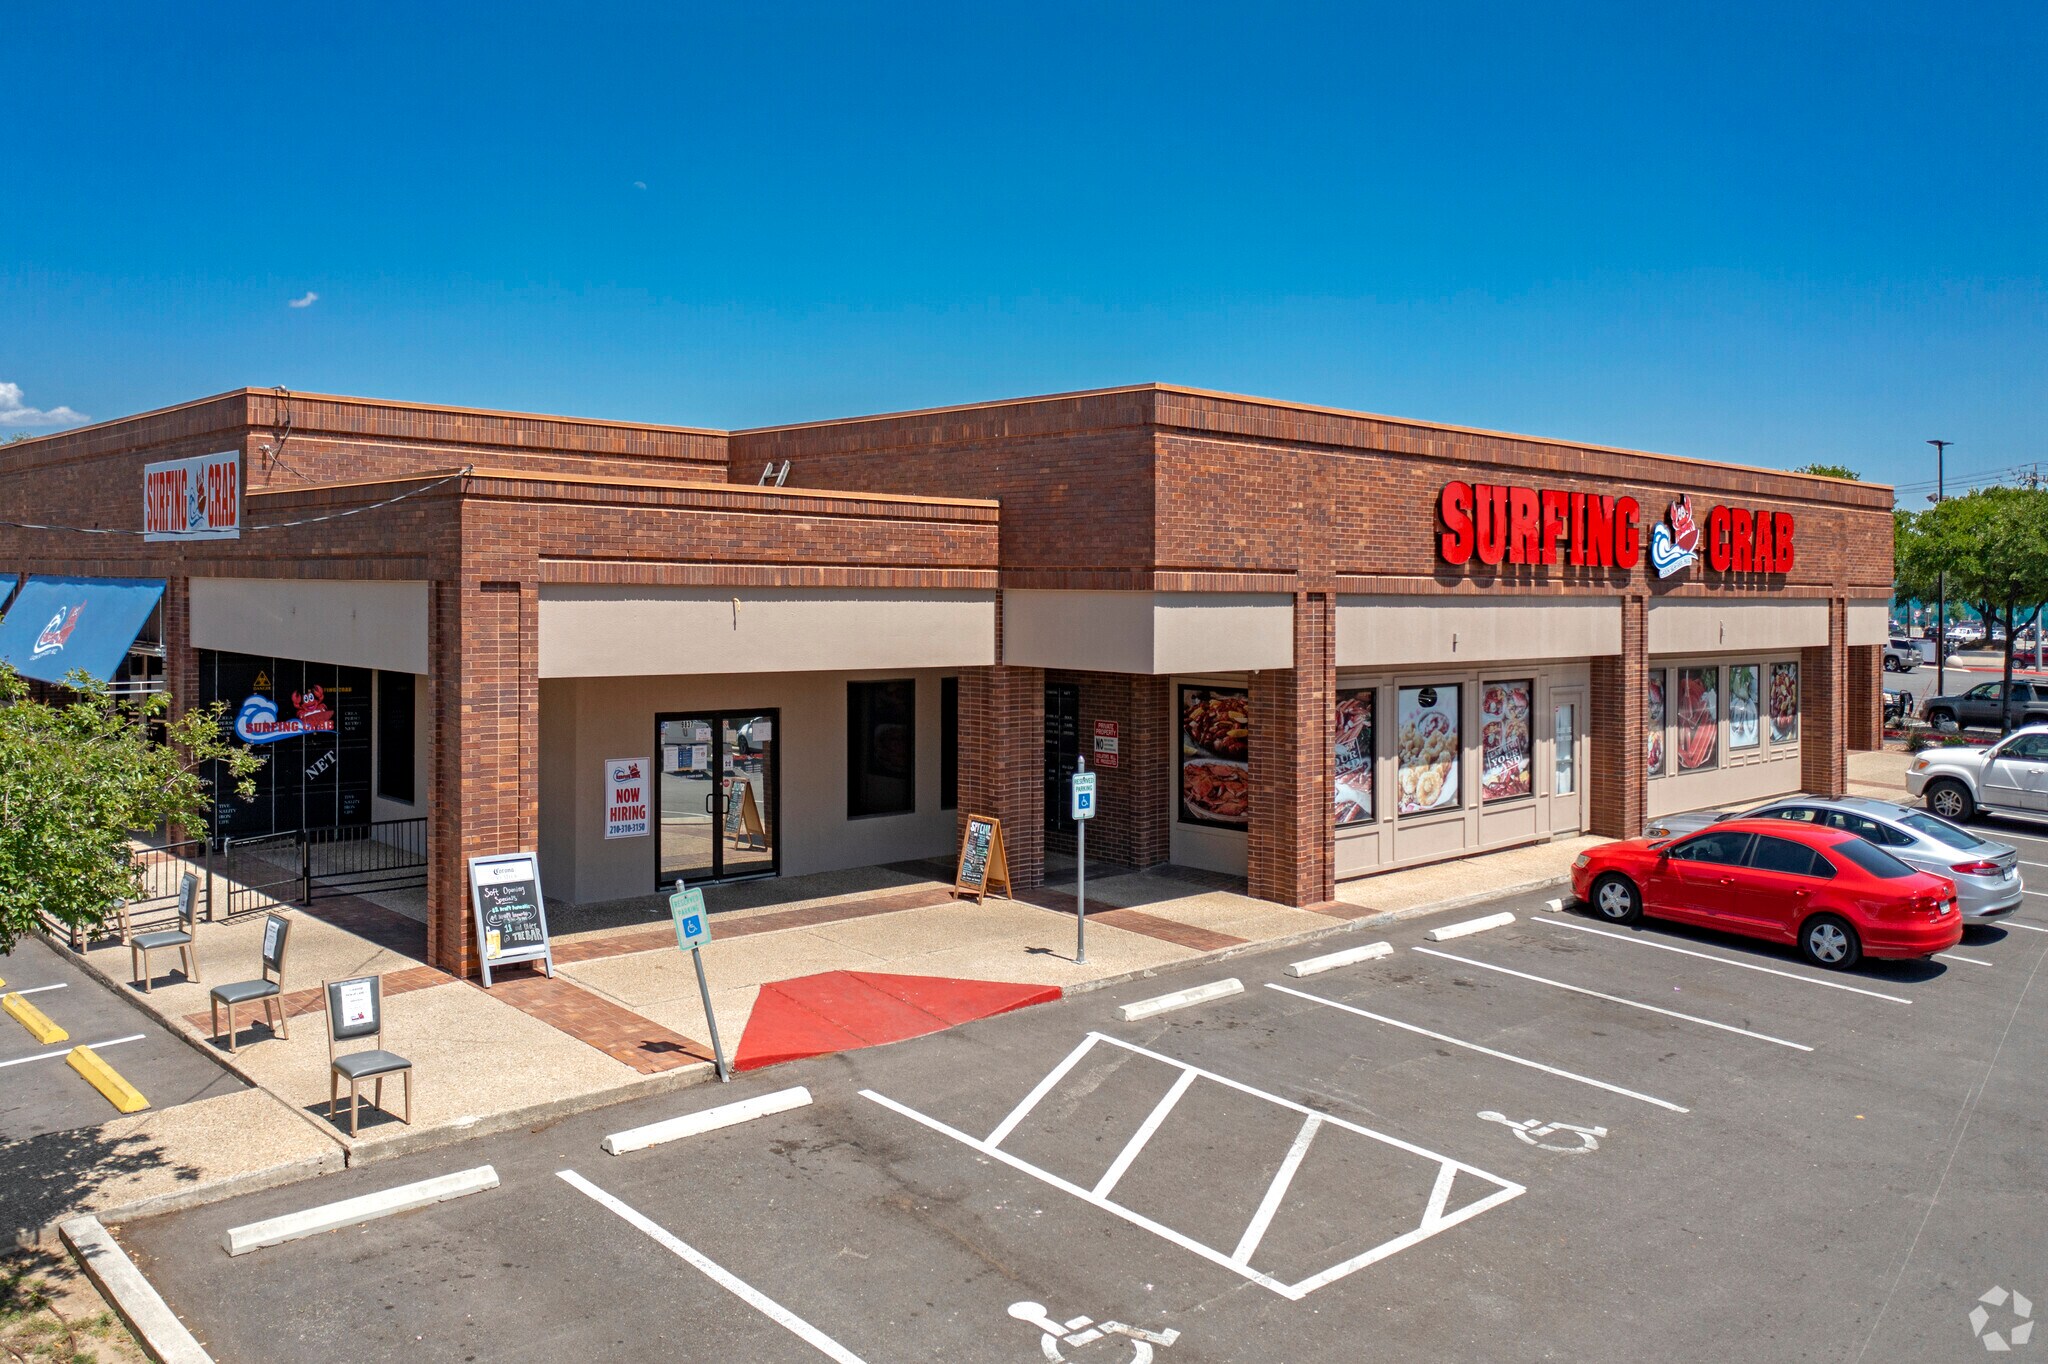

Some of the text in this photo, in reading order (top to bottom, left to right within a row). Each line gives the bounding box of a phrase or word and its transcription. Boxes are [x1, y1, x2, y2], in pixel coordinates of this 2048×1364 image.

[147, 462, 236, 532] SURFING CRAB
[1441, 481, 1794, 573] SURFING CRAB
[246, 720, 334, 734] SURFING CRAB
[1096, 738, 1104, 750] NO
[306, 750, 336, 780] NET
[1335, 751, 1358, 767] OUR
[1491, 748, 1519, 766] YOUR
[616, 788, 640, 804] NOW
[610, 805, 646, 822] HIRING
[484, 886, 525, 898] Soft Opening
[678, 905, 698, 915] PARKING
[512, 931, 525, 941] THE
[525, 928, 542, 941] BAR
